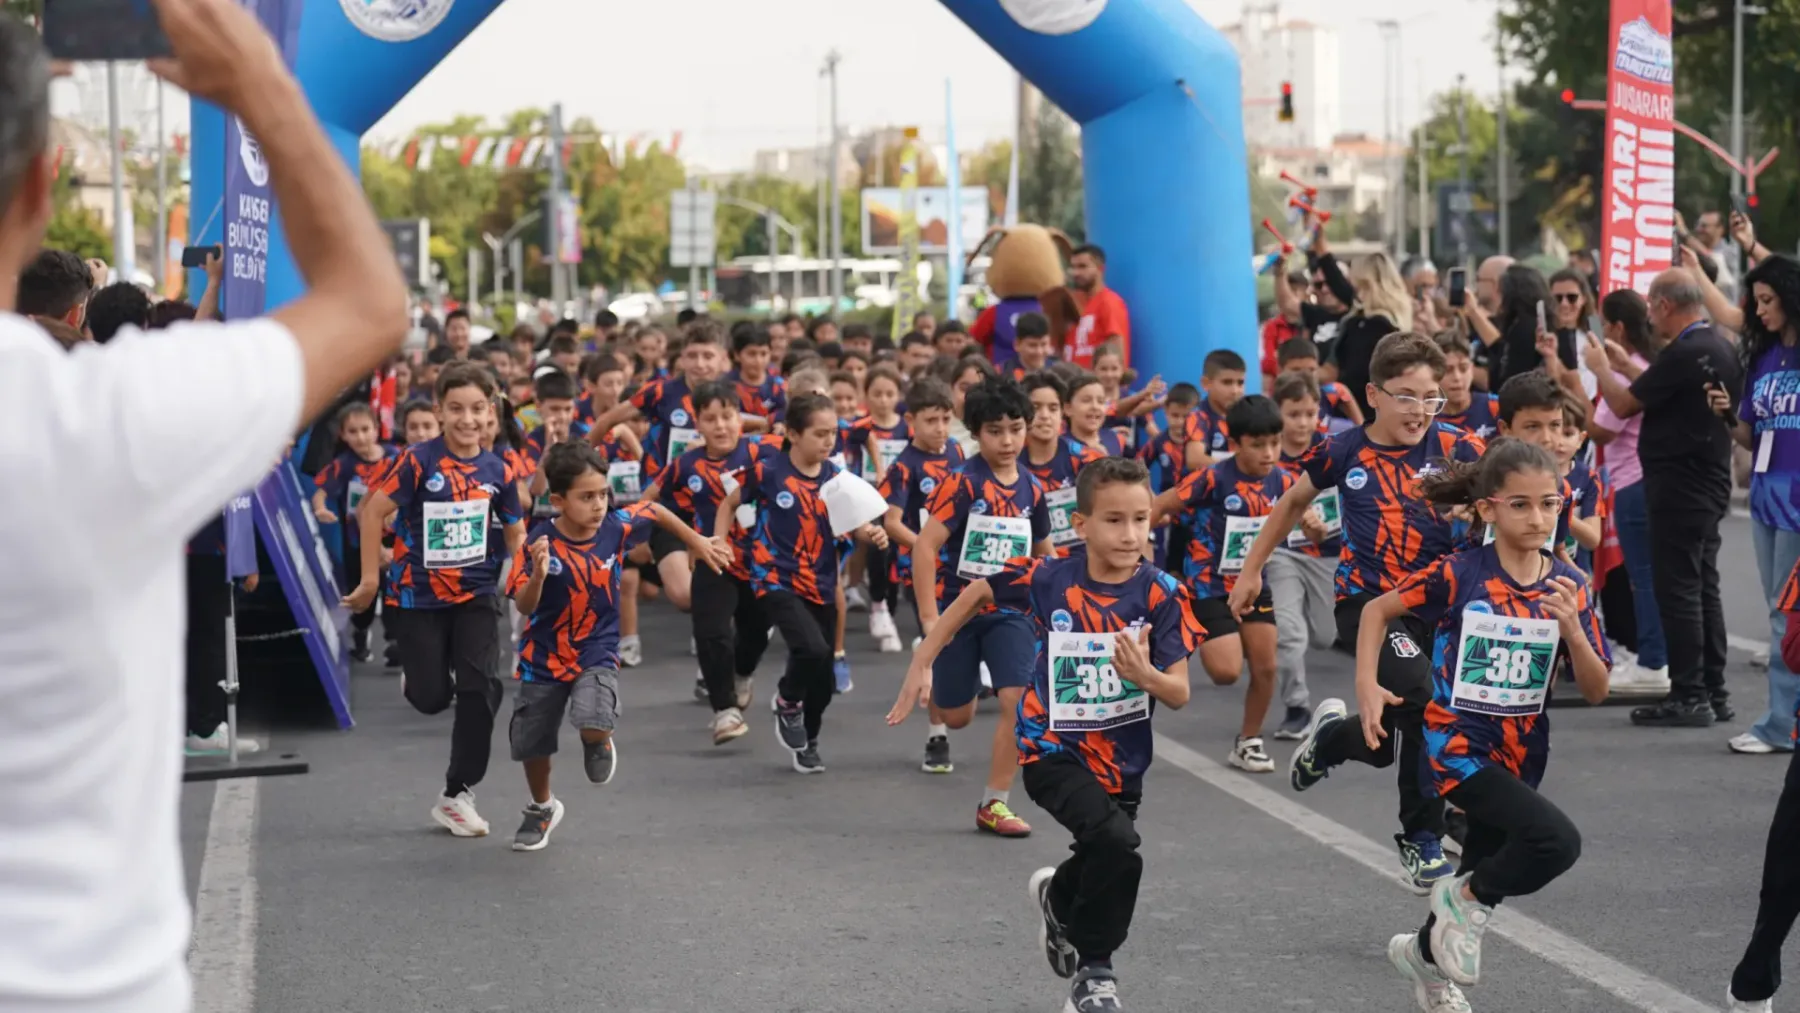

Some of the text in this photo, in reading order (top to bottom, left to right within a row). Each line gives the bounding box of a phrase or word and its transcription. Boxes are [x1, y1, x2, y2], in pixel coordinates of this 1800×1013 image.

[444, 521, 472, 547] 38
[981, 537, 1013, 562] 38
[1485, 647, 1532, 684] 38
[1076, 664, 1122, 699] 38
